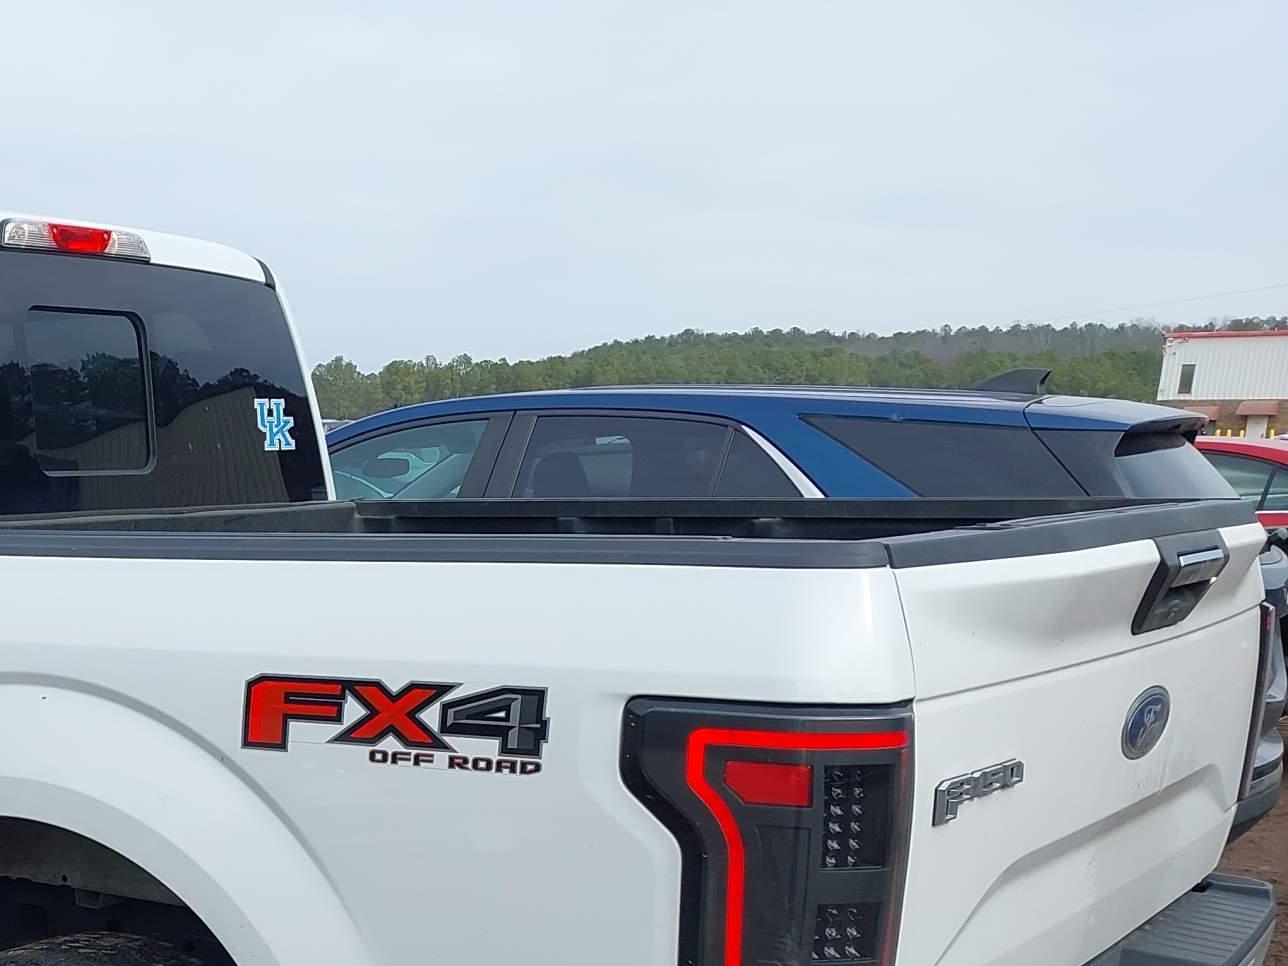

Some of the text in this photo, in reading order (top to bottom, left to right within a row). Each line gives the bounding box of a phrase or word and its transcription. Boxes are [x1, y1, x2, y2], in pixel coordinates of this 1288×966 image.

[253, 397, 296, 451] UK
[240, 672, 551, 759] FX4
[367, 748, 544, 776] OFF ROAD
